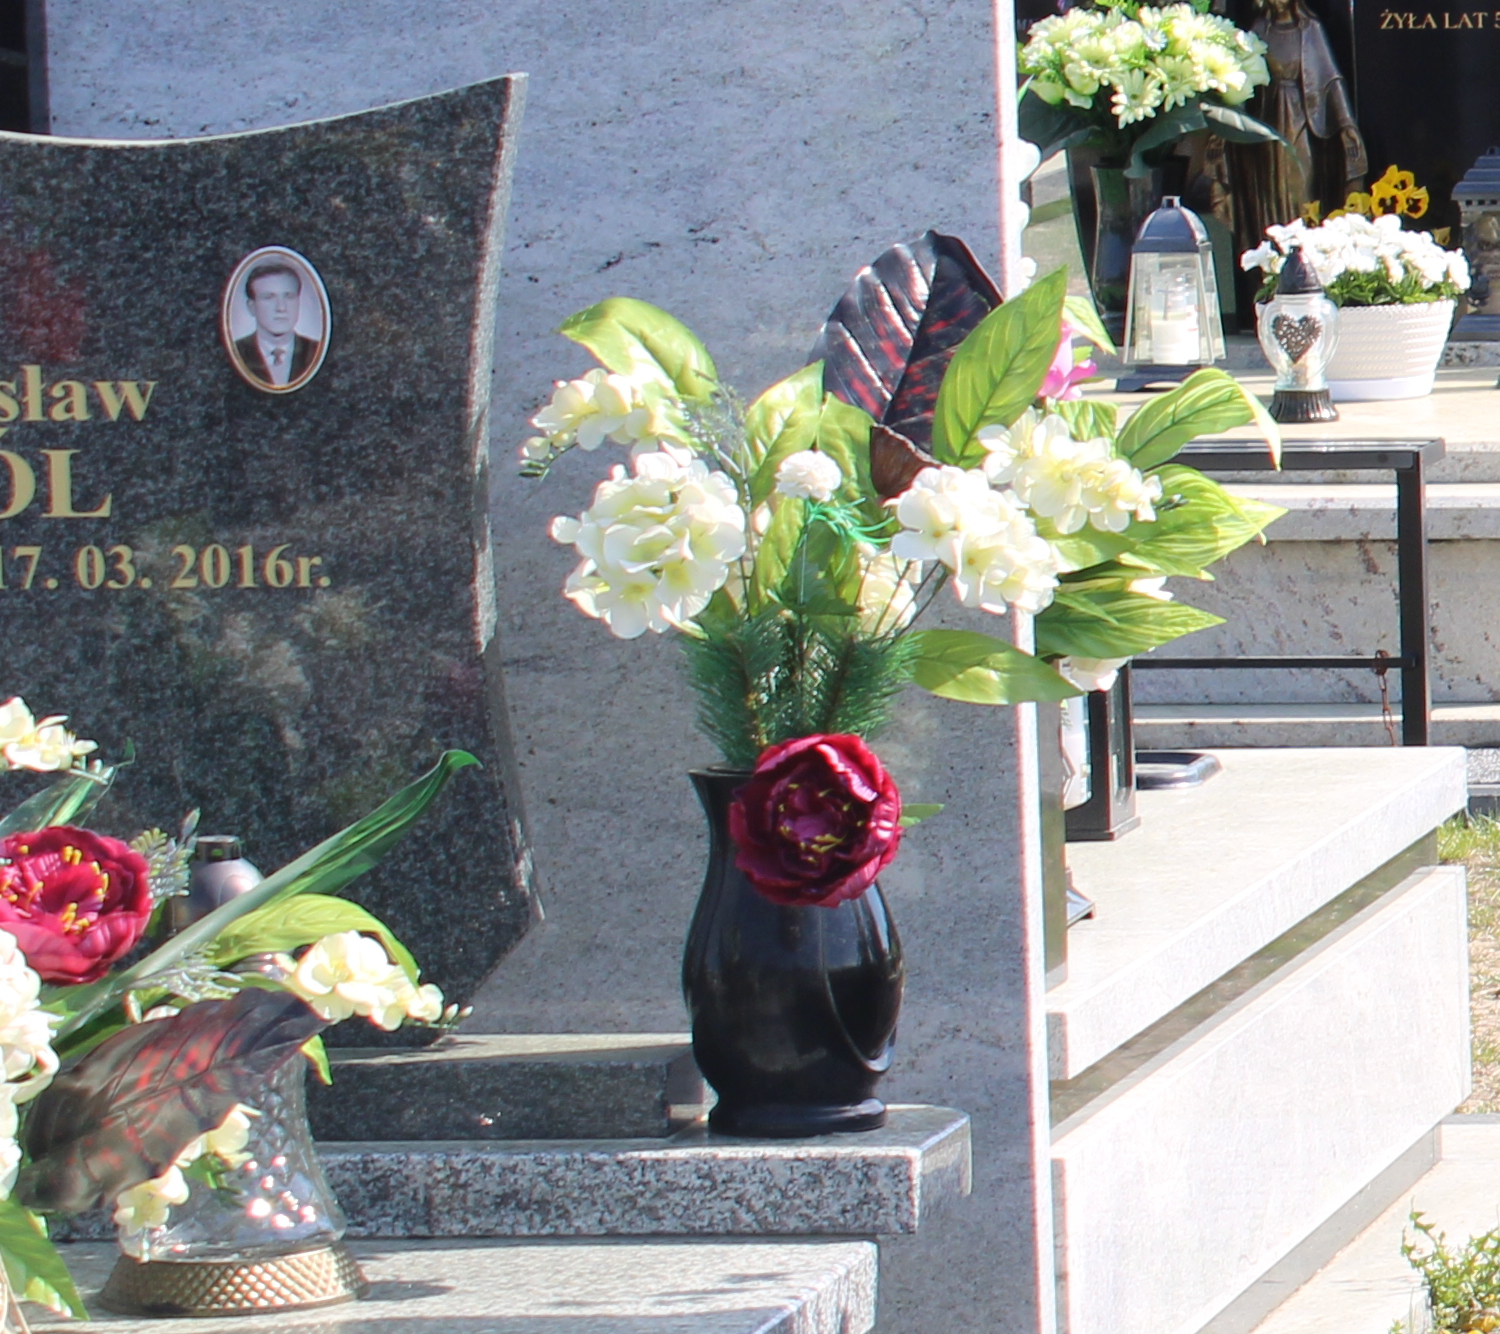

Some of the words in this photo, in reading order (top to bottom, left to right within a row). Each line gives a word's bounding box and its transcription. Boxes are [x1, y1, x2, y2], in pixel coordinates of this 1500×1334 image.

[1380, 8, 1437, 30] ŻYŁA
[1443, 12, 1488, 30] LAT
[74, 543, 153, 590] 03.
[168, 543, 332, 590] 2016r.
